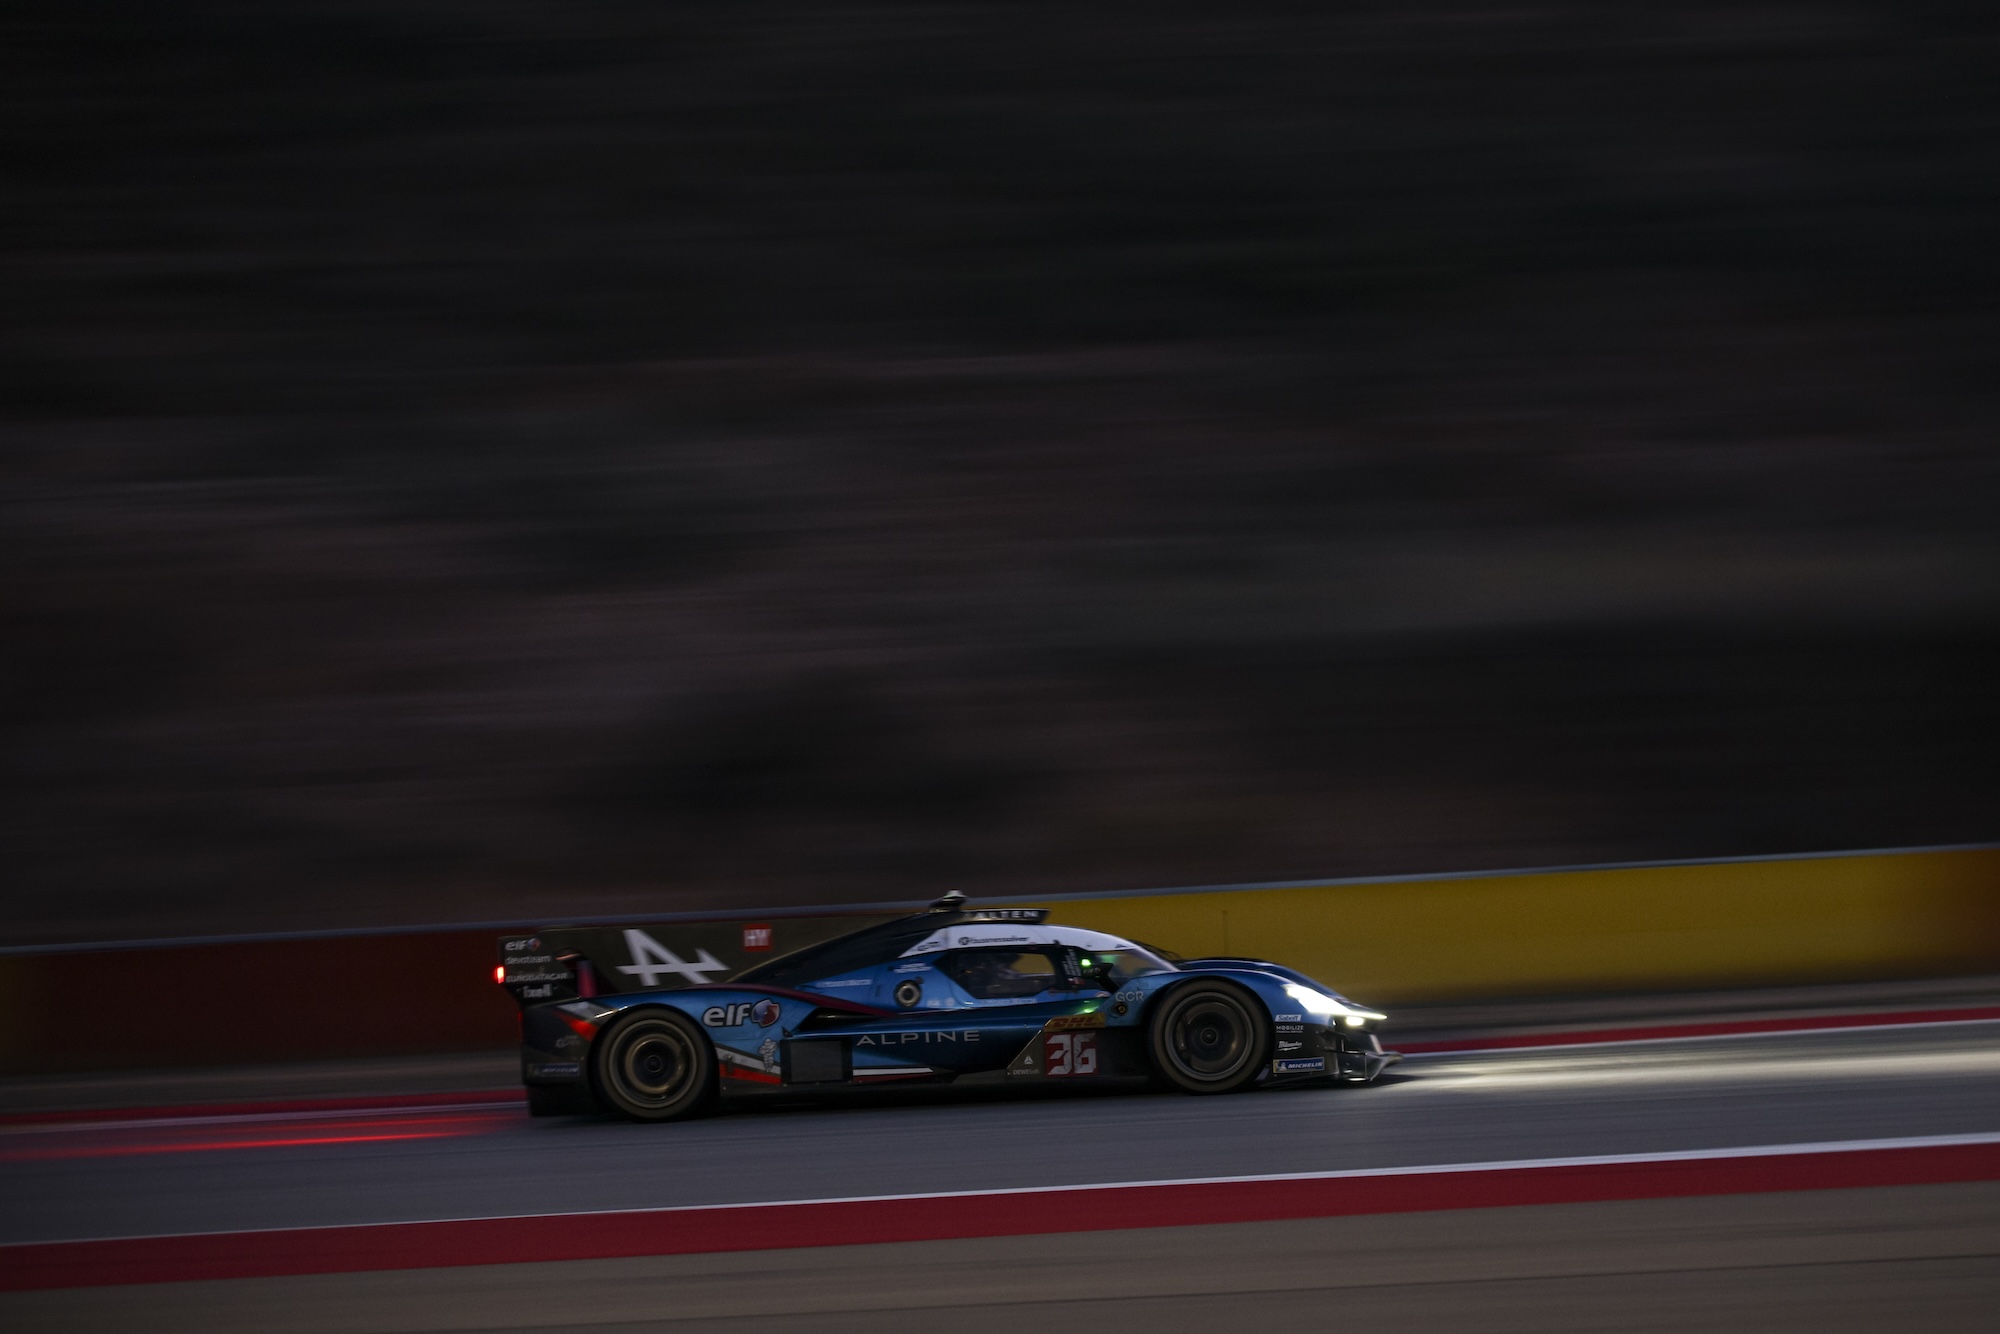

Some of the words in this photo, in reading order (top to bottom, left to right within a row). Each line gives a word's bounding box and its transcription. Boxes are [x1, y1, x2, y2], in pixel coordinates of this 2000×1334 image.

[505, 940, 527, 951] elf
[505, 955, 552, 965] devoteam
[1115, 991, 1145, 1002] GCR
[702, 1003, 750, 1027] elf
[1052, 1017, 1097, 1028] DHL
[856, 1030, 981, 1047] ALPINE
[1046, 1033, 1097, 1076] 36
